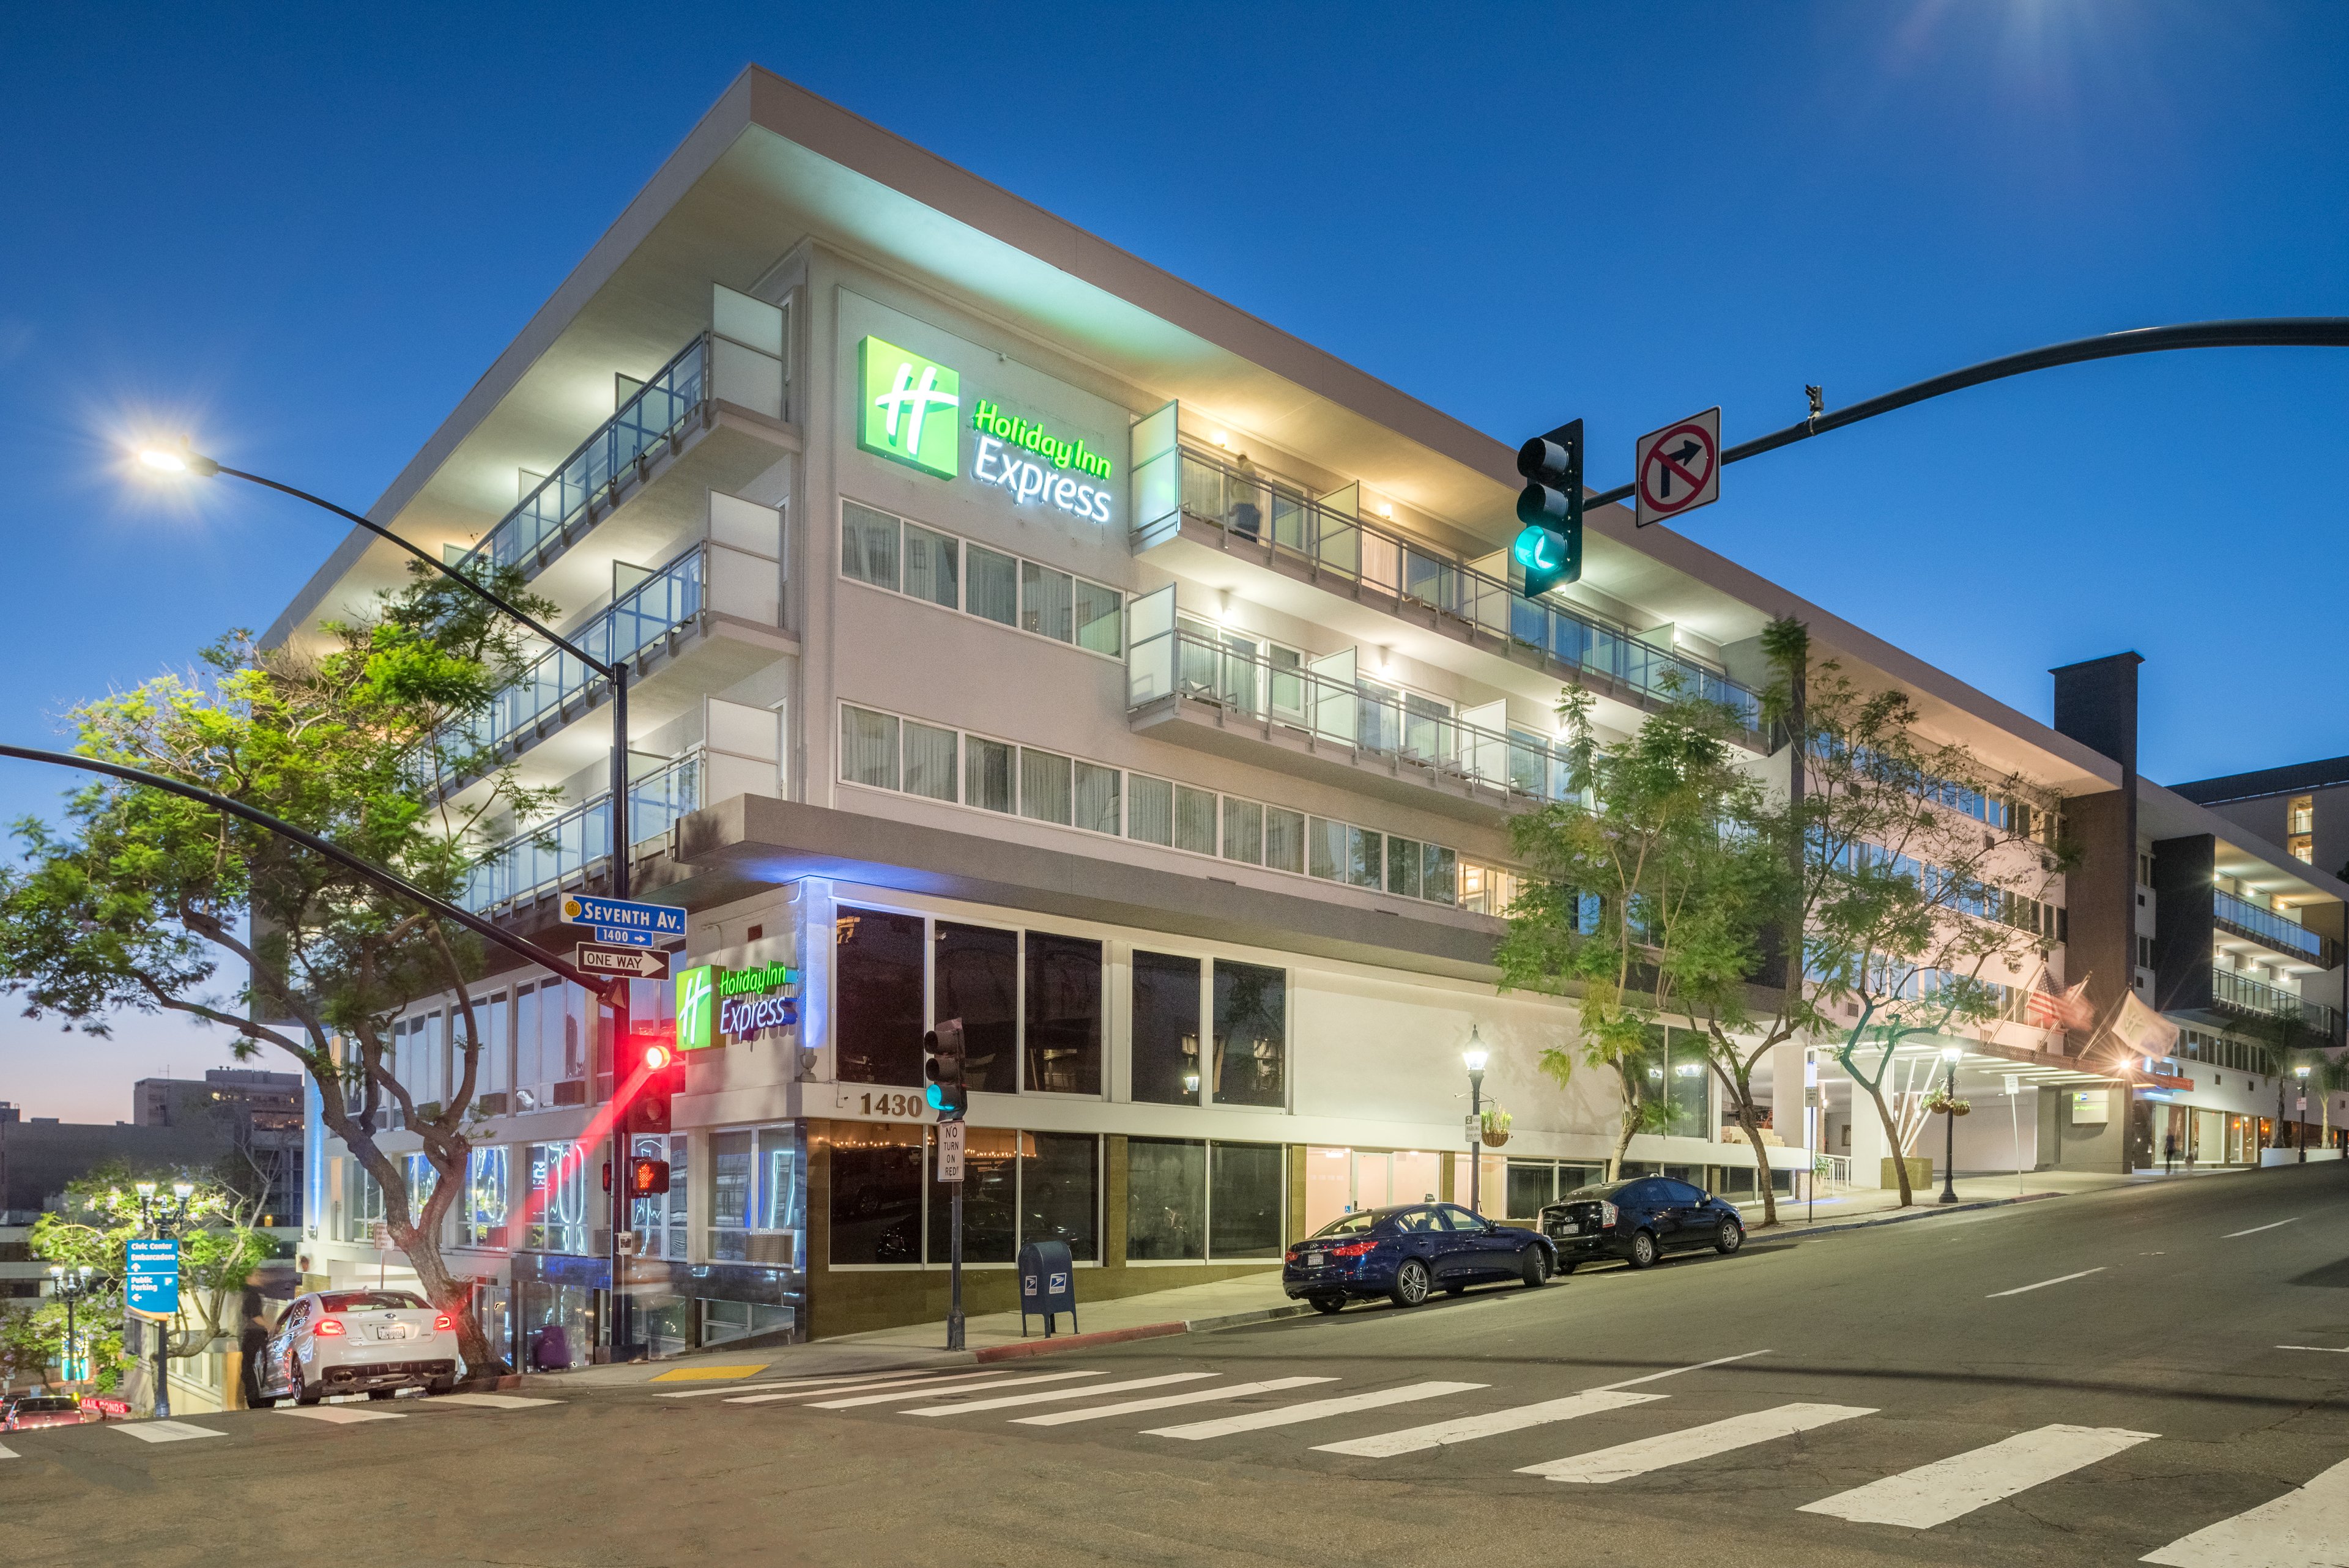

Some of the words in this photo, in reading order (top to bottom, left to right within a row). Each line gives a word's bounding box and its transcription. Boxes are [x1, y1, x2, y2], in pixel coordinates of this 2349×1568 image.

[975, 399, 1073, 470] Holiday
[1074, 439, 1112, 480] Inn
[974, 435, 1112, 523] Express
[584, 901, 650, 926] SEVENTH
[603, 929, 628, 942] 1400
[587, 953, 612, 966] ONE
[617, 956, 642, 969] WAY
[719, 966, 766, 997] Holiday
[766, 960, 787, 986] Inn
[719, 996, 786, 1041] Express
[860, 1092, 923, 1117] 1430
[946, 1126, 957, 1138] NO
[944, 1141, 959, 1151] TURN
[946, 1154, 956, 1163] ON
[945, 1166, 957, 1176] RED
[81, 1399, 98, 1410] BAIL
